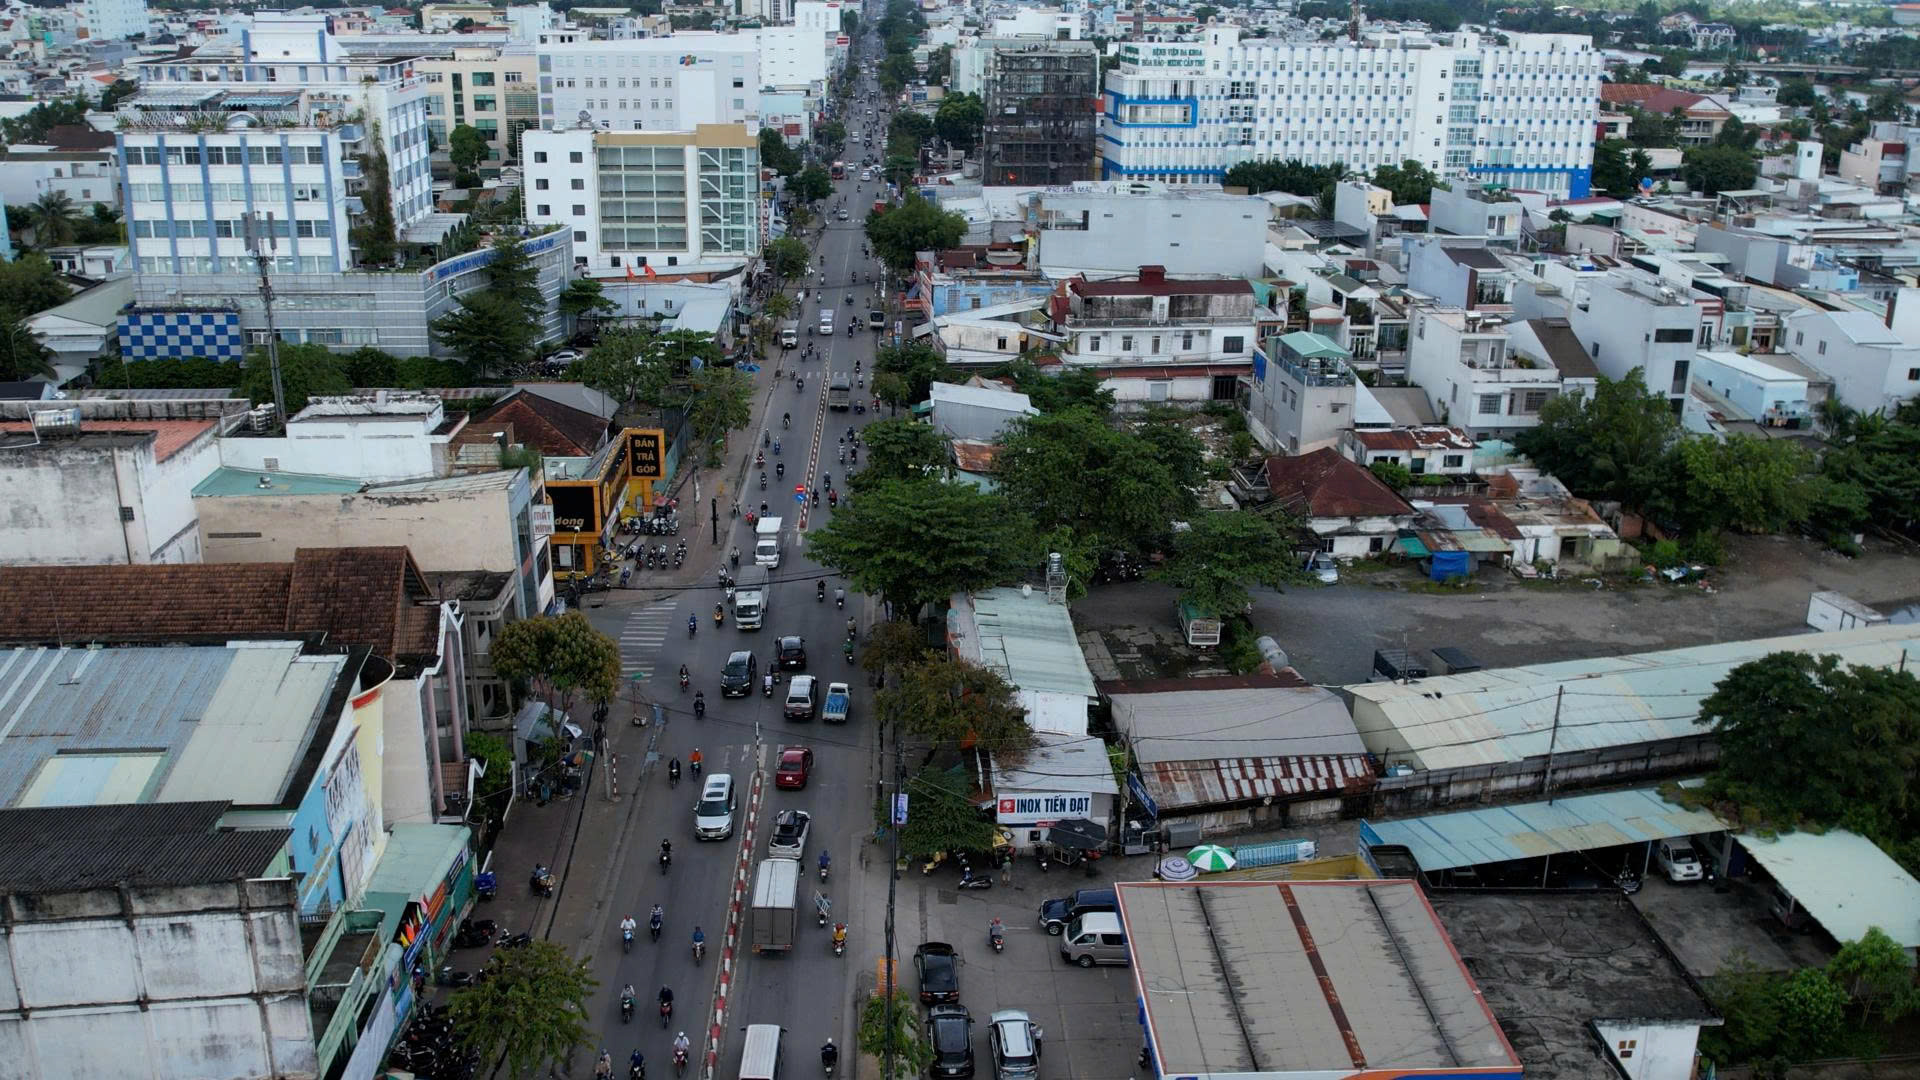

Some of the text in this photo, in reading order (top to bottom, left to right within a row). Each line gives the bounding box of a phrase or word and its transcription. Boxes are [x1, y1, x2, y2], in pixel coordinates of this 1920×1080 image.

[635, 438, 655, 448] BÁN
[636, 450, 655, 461] TRẢ
[636, 463, 656, 473] GÓP
[1016, 794, 1090, 815] INOX TIẾN ĐẠT
